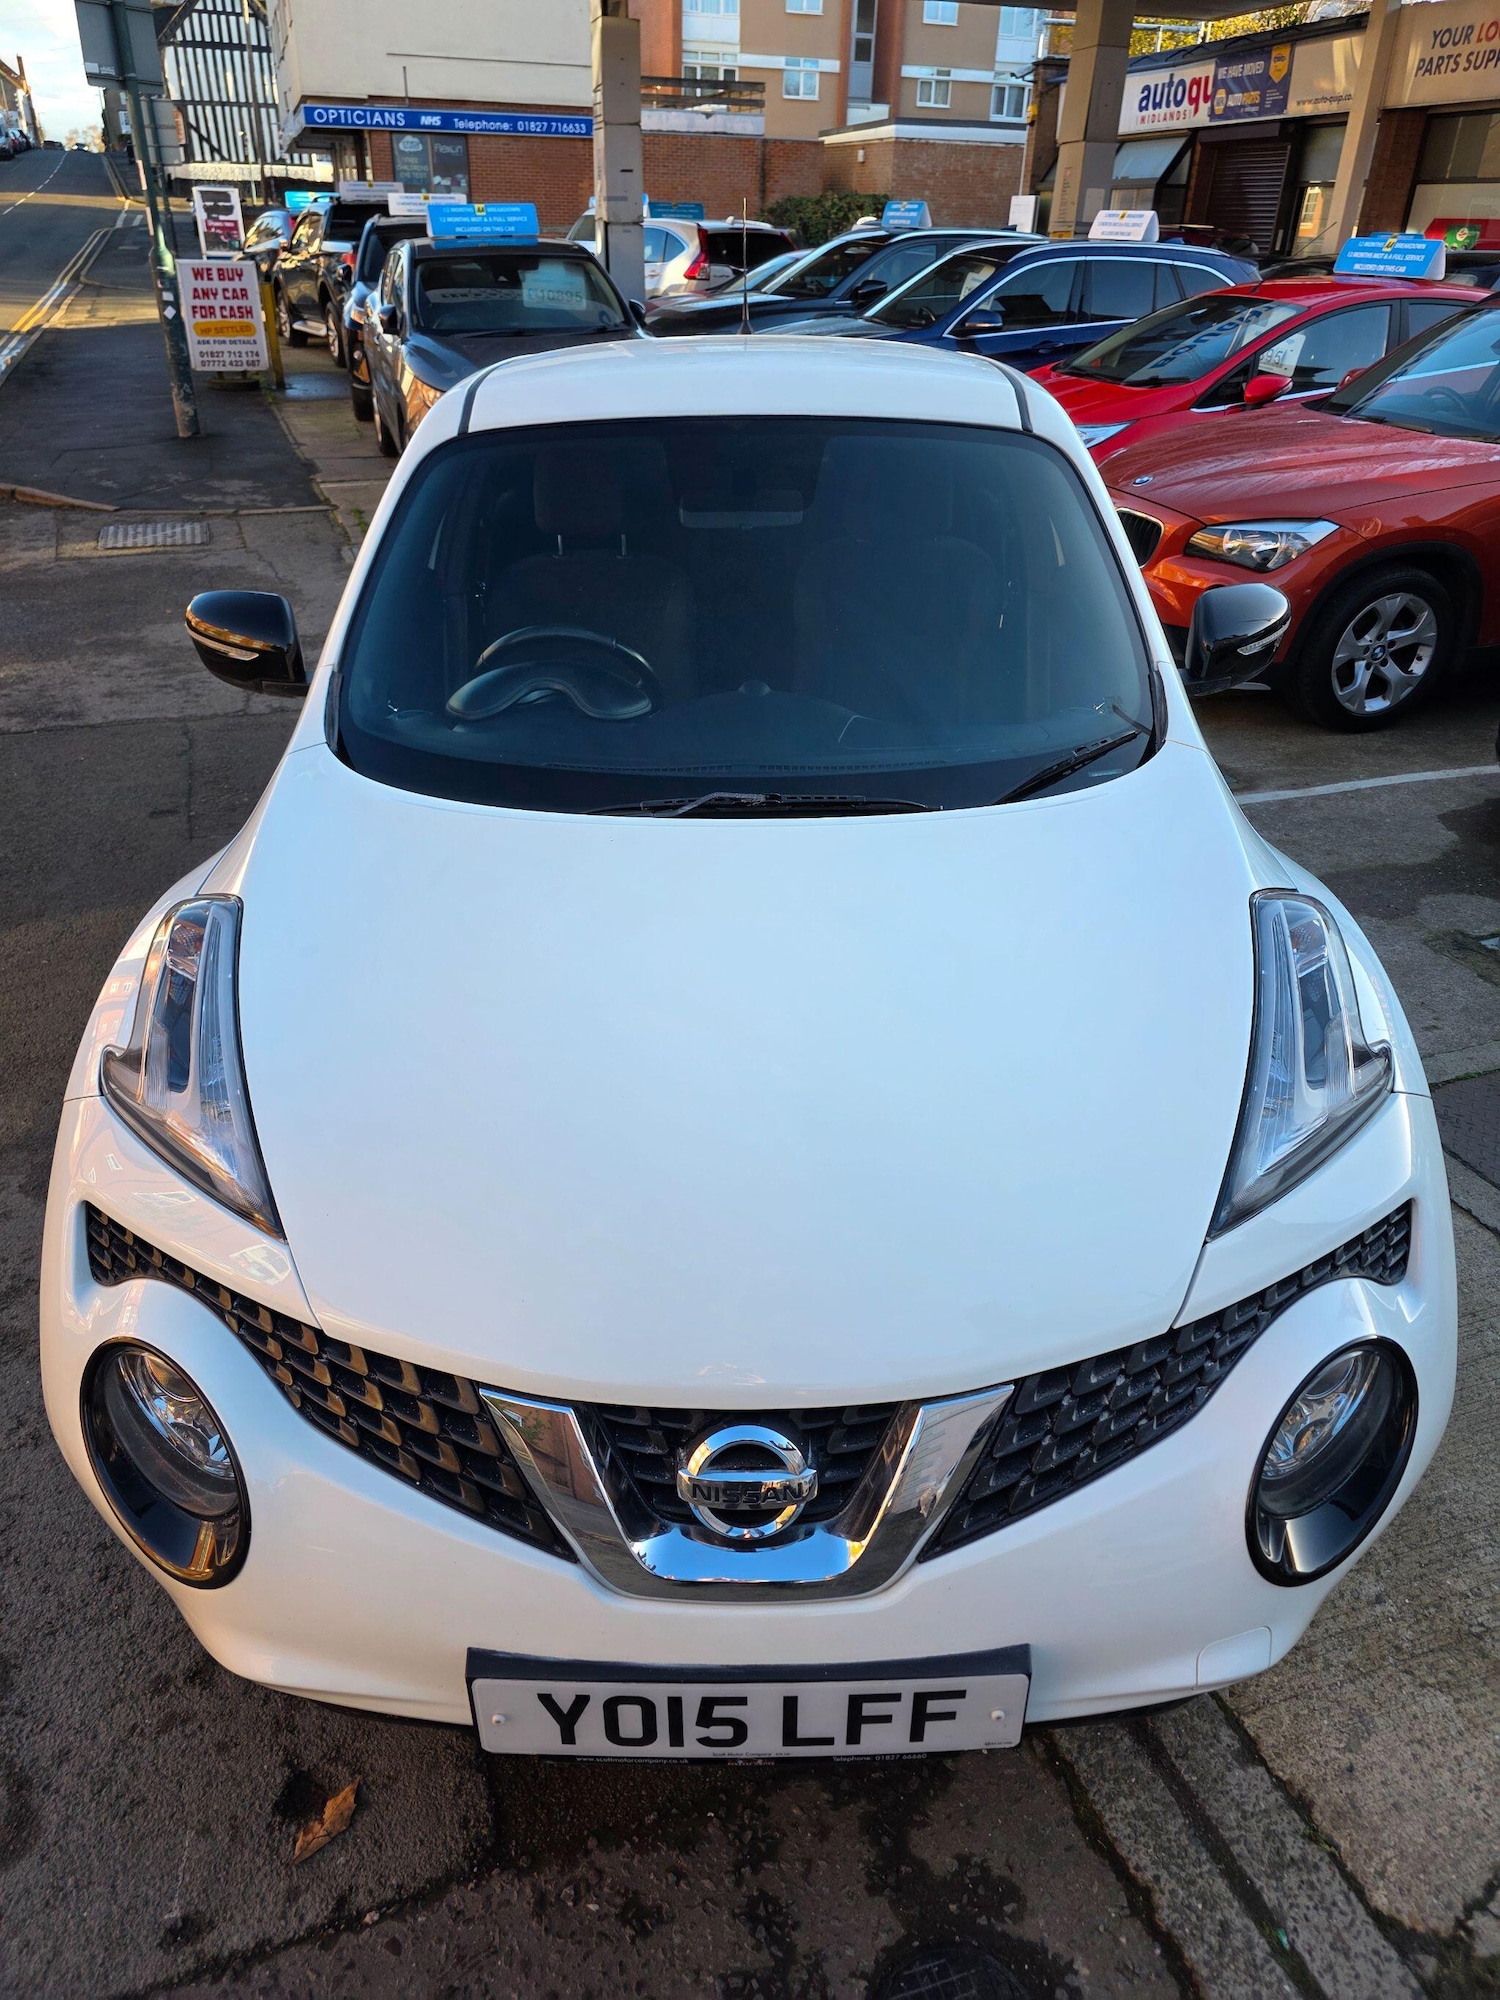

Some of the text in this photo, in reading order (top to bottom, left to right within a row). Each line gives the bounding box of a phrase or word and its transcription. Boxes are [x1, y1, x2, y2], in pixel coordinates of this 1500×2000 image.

[1431, 20, 1500, 50] YOUR LO
[1243, 61, 1265, 77] MOVED
[1414, 53, 1462, 78] PARTS
[313, 108, 406, 127] OPTICIANS
[420, 115, 442, 126] NHS
[454, 117, 513, 131] Telephone:
[517, 120, 547, 132] 01827
[1139, 109, 1188, 125] MIDLANDS
[192, 267, 244, 281] WE BUY
[192, 287, 249, 300] ANY CAR
[192, 305, 254, 319] FOR CASH
[213, 325, 252, 334] SETTLED
[199, 350, 260, 358] 01827 712 174
[691, 1482, 804, 1506] NISSAN
[536, 1689, 967, 1748] YO15 LFF
